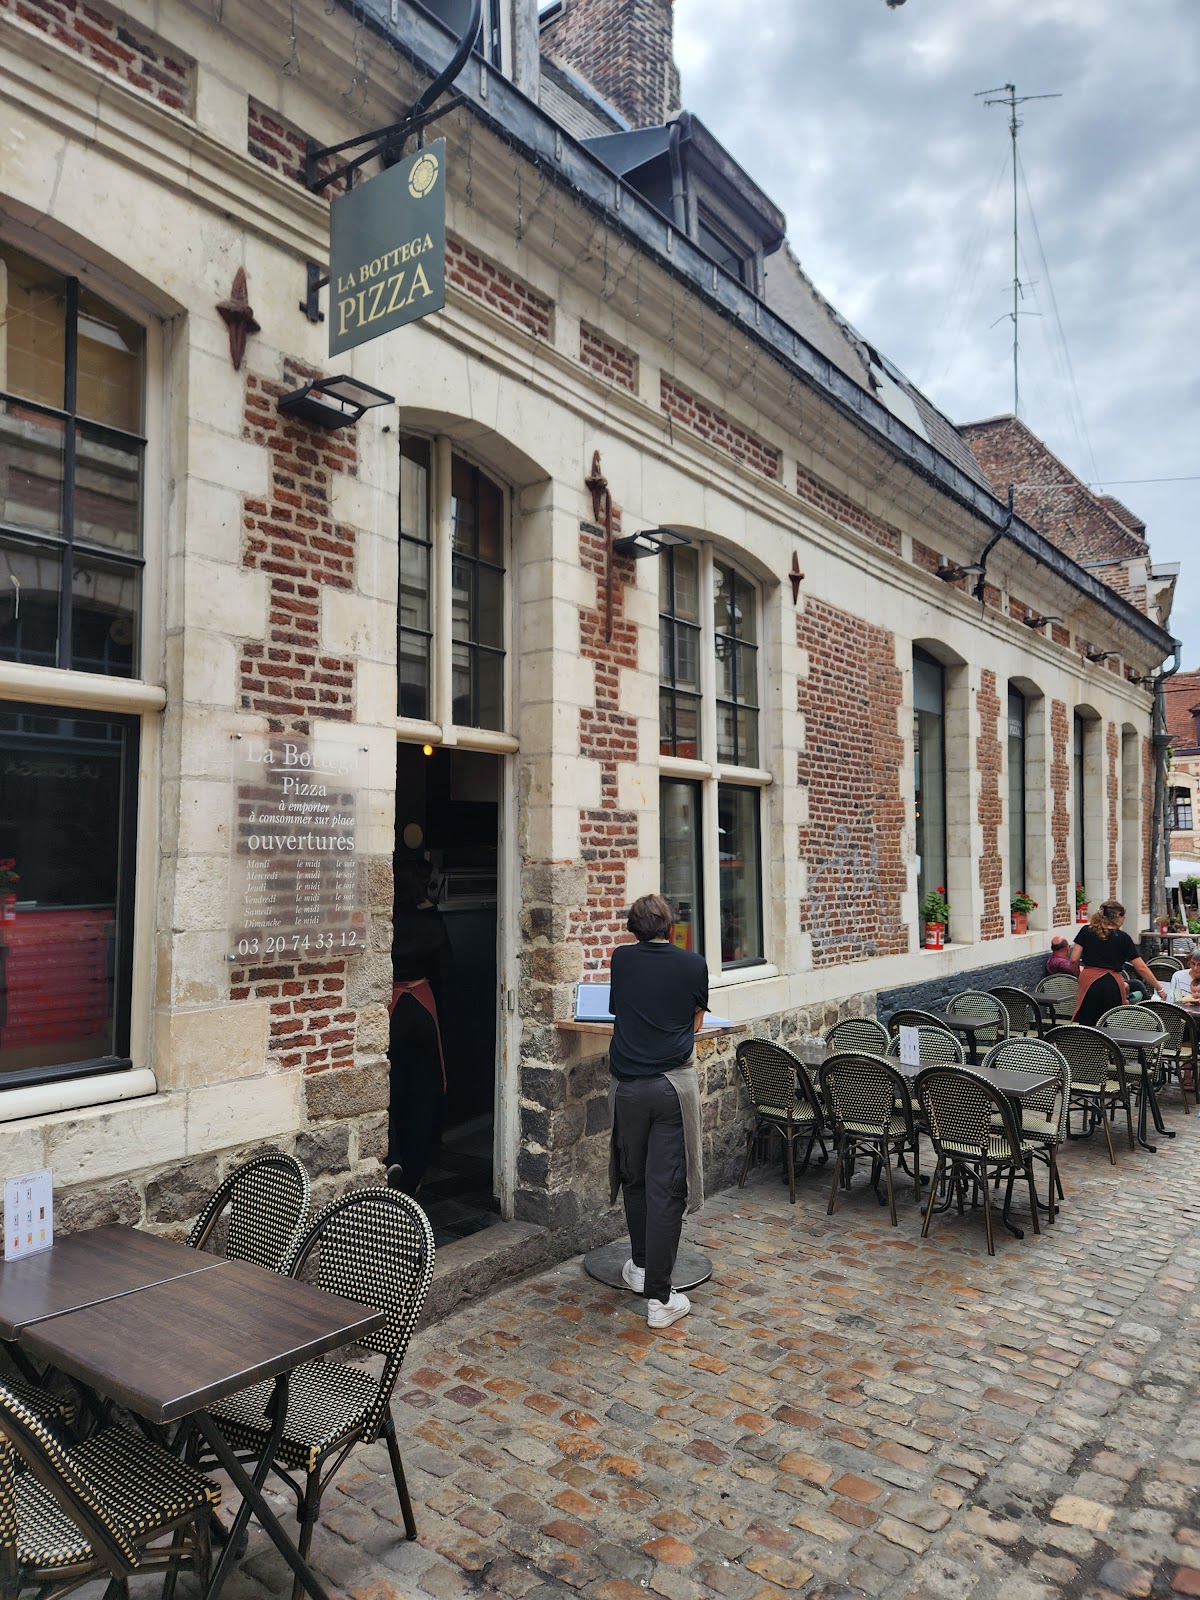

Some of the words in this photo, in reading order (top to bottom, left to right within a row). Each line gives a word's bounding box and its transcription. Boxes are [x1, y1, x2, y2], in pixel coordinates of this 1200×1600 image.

[337, 272, 357, 294] LA
[359, 233, 434, 283] BOTTEGA
[337, 262, 434, 336] PIZZA
[245, 740, 276, 763] La
[281, 776, 328, 797] Pizza
[278, 800, 286, 811] à
[288, 802, 331, 815] emporter
[248, 811, 256, 823] à
[258, 814, 313, 825] consommer
[314, 816, 330, 825] sur
[331, 813, 356, 828] place
[247, 832, 355, 851] ouvertures
[296, 859, 304, 868] le
[304, 859, 321, 868] midi
[246, 871, 279, 880] Mercredi
[296, 870, 304, 879] le
[304, 870, 321, 879] midi
[295, 882, 303, 891] le
[304, 882, 321, 890] midi
[295, 893, 303, 902] le
[304, 893, 320, 902] midi
[295, 905, 303, 914] le
[303, 904, 320, 913] midi
[244, 917, 282, 929] Dimanche
[294, 916, 302, 926] le
[303, 915, 320, 925] midi
[238, 938, 259, 955] 03
[265, 936, 286, 953] 20
[291, 934, 311, 951] 74
[315, 932, 334, 949] 33
[340, 931, 357, 947] 12
